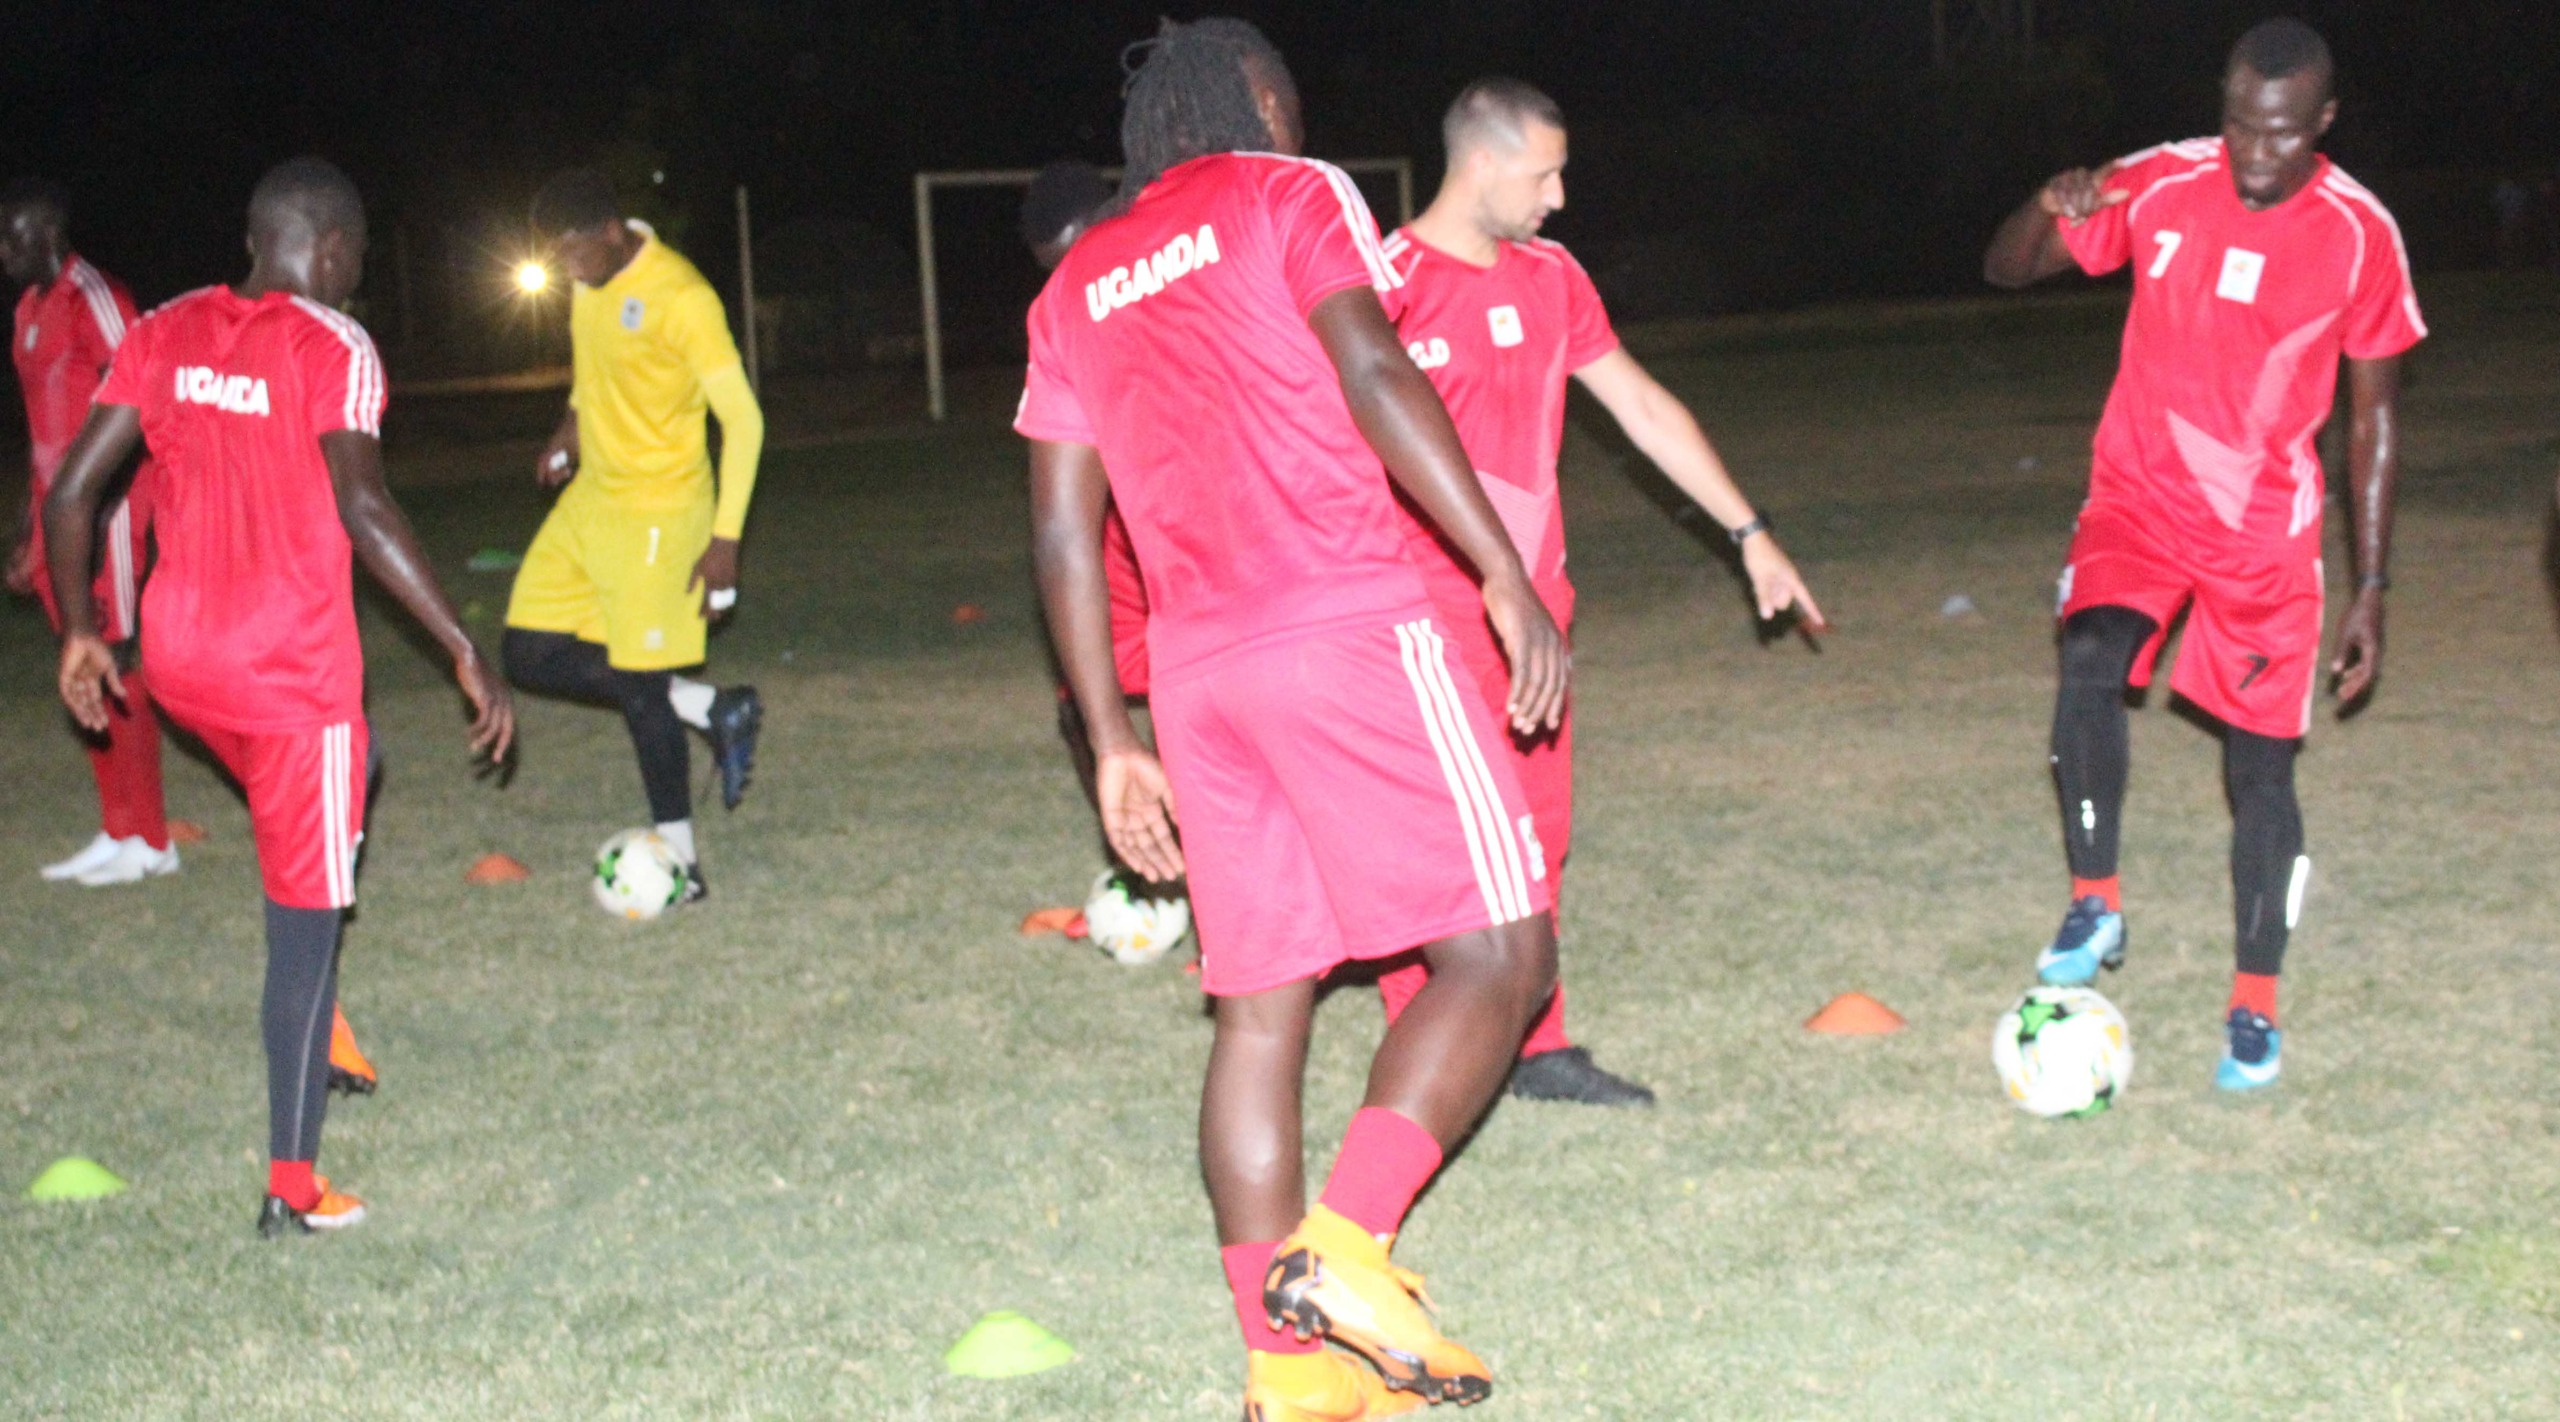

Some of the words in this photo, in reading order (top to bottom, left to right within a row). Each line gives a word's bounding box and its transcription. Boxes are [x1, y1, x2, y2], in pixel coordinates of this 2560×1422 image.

[1086, 224, 1220, 322] UGANDA
[2148, 229, 2182, 278] 7
[647, 526, 660, 565] 1
[2239, 653, 2269, 690] 7
